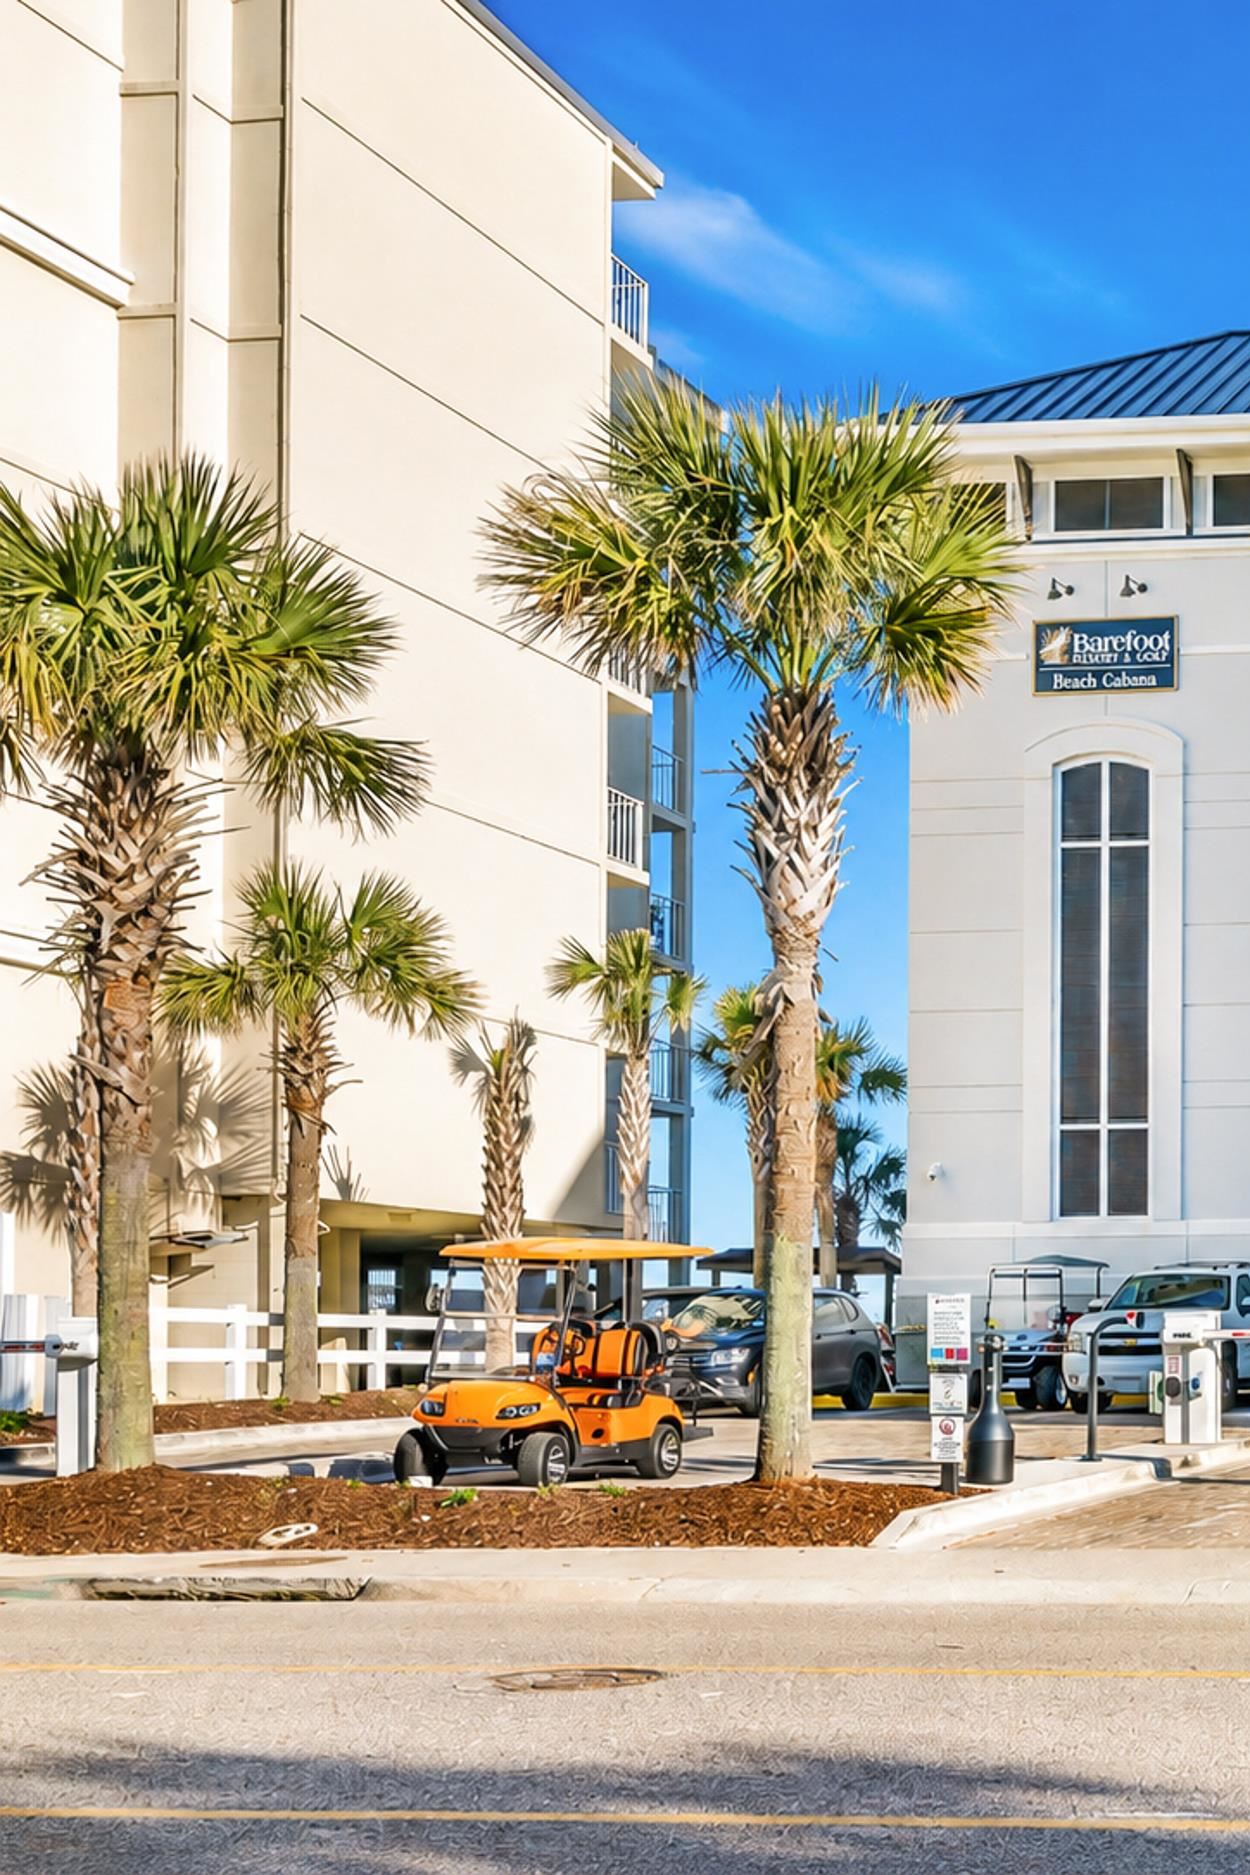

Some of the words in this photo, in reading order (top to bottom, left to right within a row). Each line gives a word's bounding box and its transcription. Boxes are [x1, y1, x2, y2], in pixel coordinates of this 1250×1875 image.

[1073, 630, 1171, 651] Barefoot
[1053, 672, 1097, 689] Beach
[1102, 672, 1157, 687] Cabana
